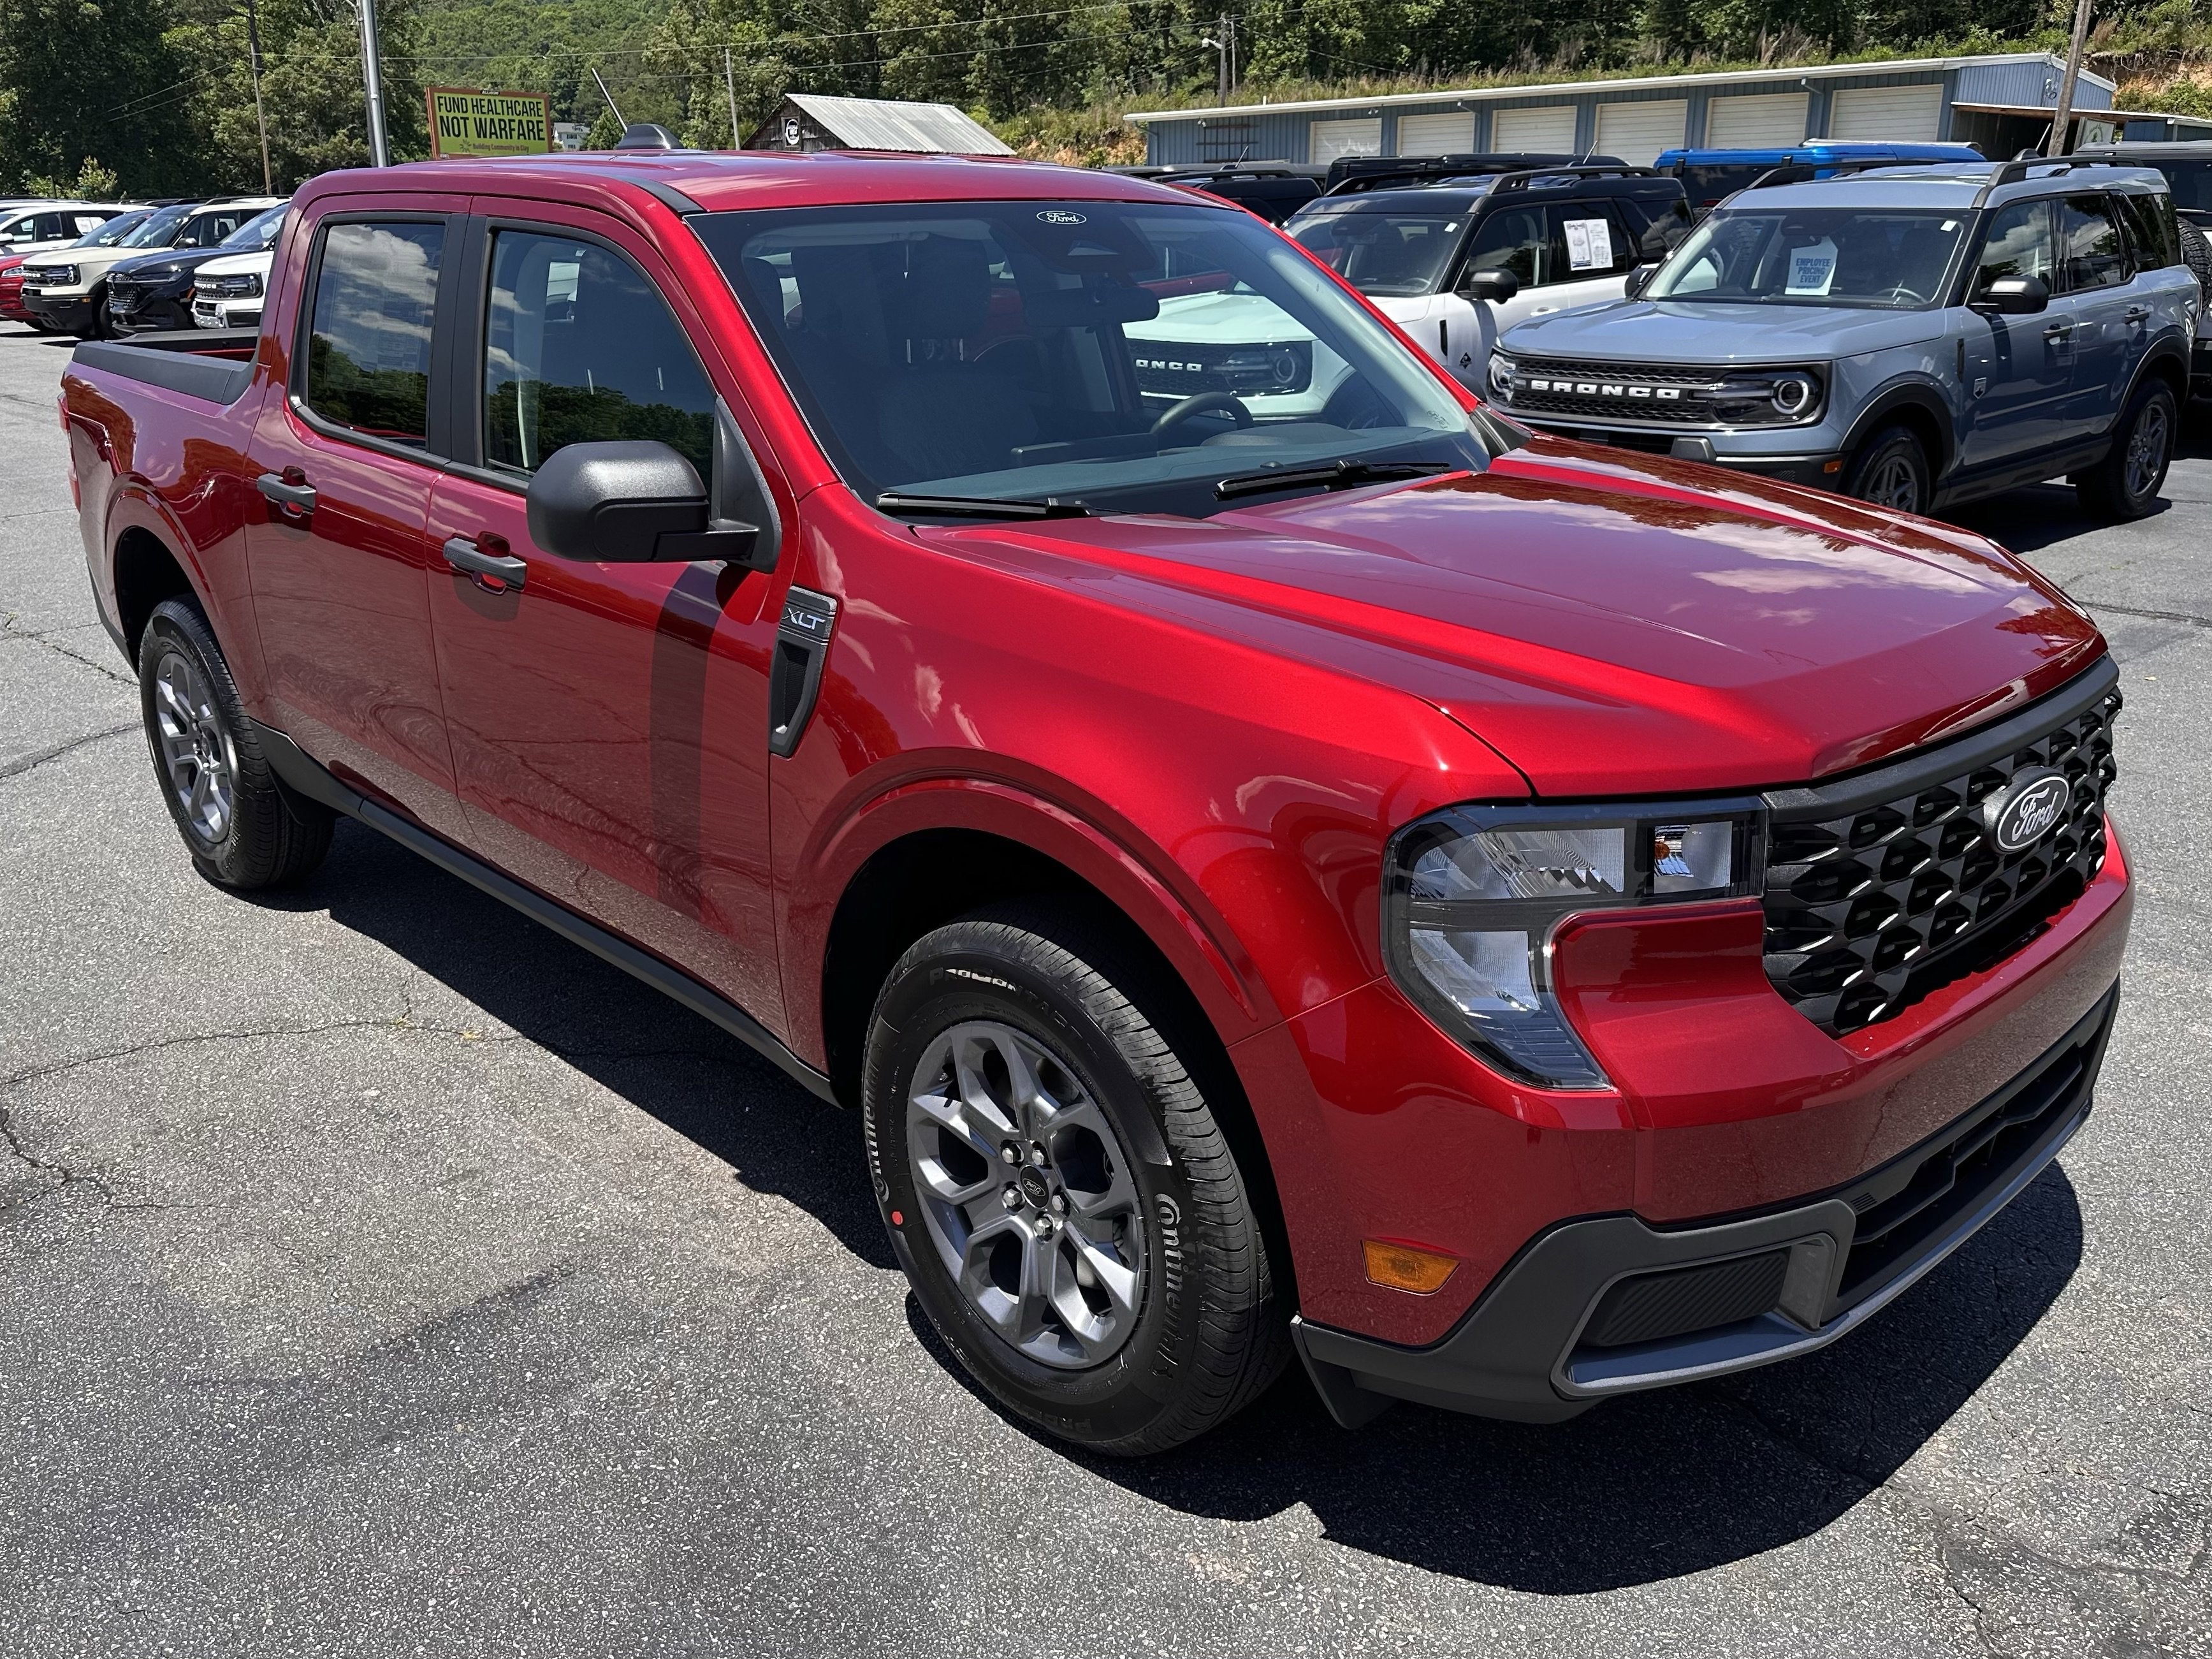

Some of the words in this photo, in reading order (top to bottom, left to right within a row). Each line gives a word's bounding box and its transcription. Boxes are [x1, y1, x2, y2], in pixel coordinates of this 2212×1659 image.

[437, 96, 468, 113] FUND
[471, 98, 543, 117] HEALTHCARE
[440, 115, 469, 138] NOT
[474, 117, 545, 141] WARFARE
[1046, 212, 1079, 222] Ford
[1796, 258, 1831, 267] EMPLOYEE
[1798, 267, 1825, 275] PRICING
[1800, 275, 1821, 283] EVENT
[1135, 359, 1202, 372] ONCO
[1531, 379, 1680, 400] BRONCO
[782, 607, 826, 630] XLT
[2012, 787, 2059, 842] Ford
